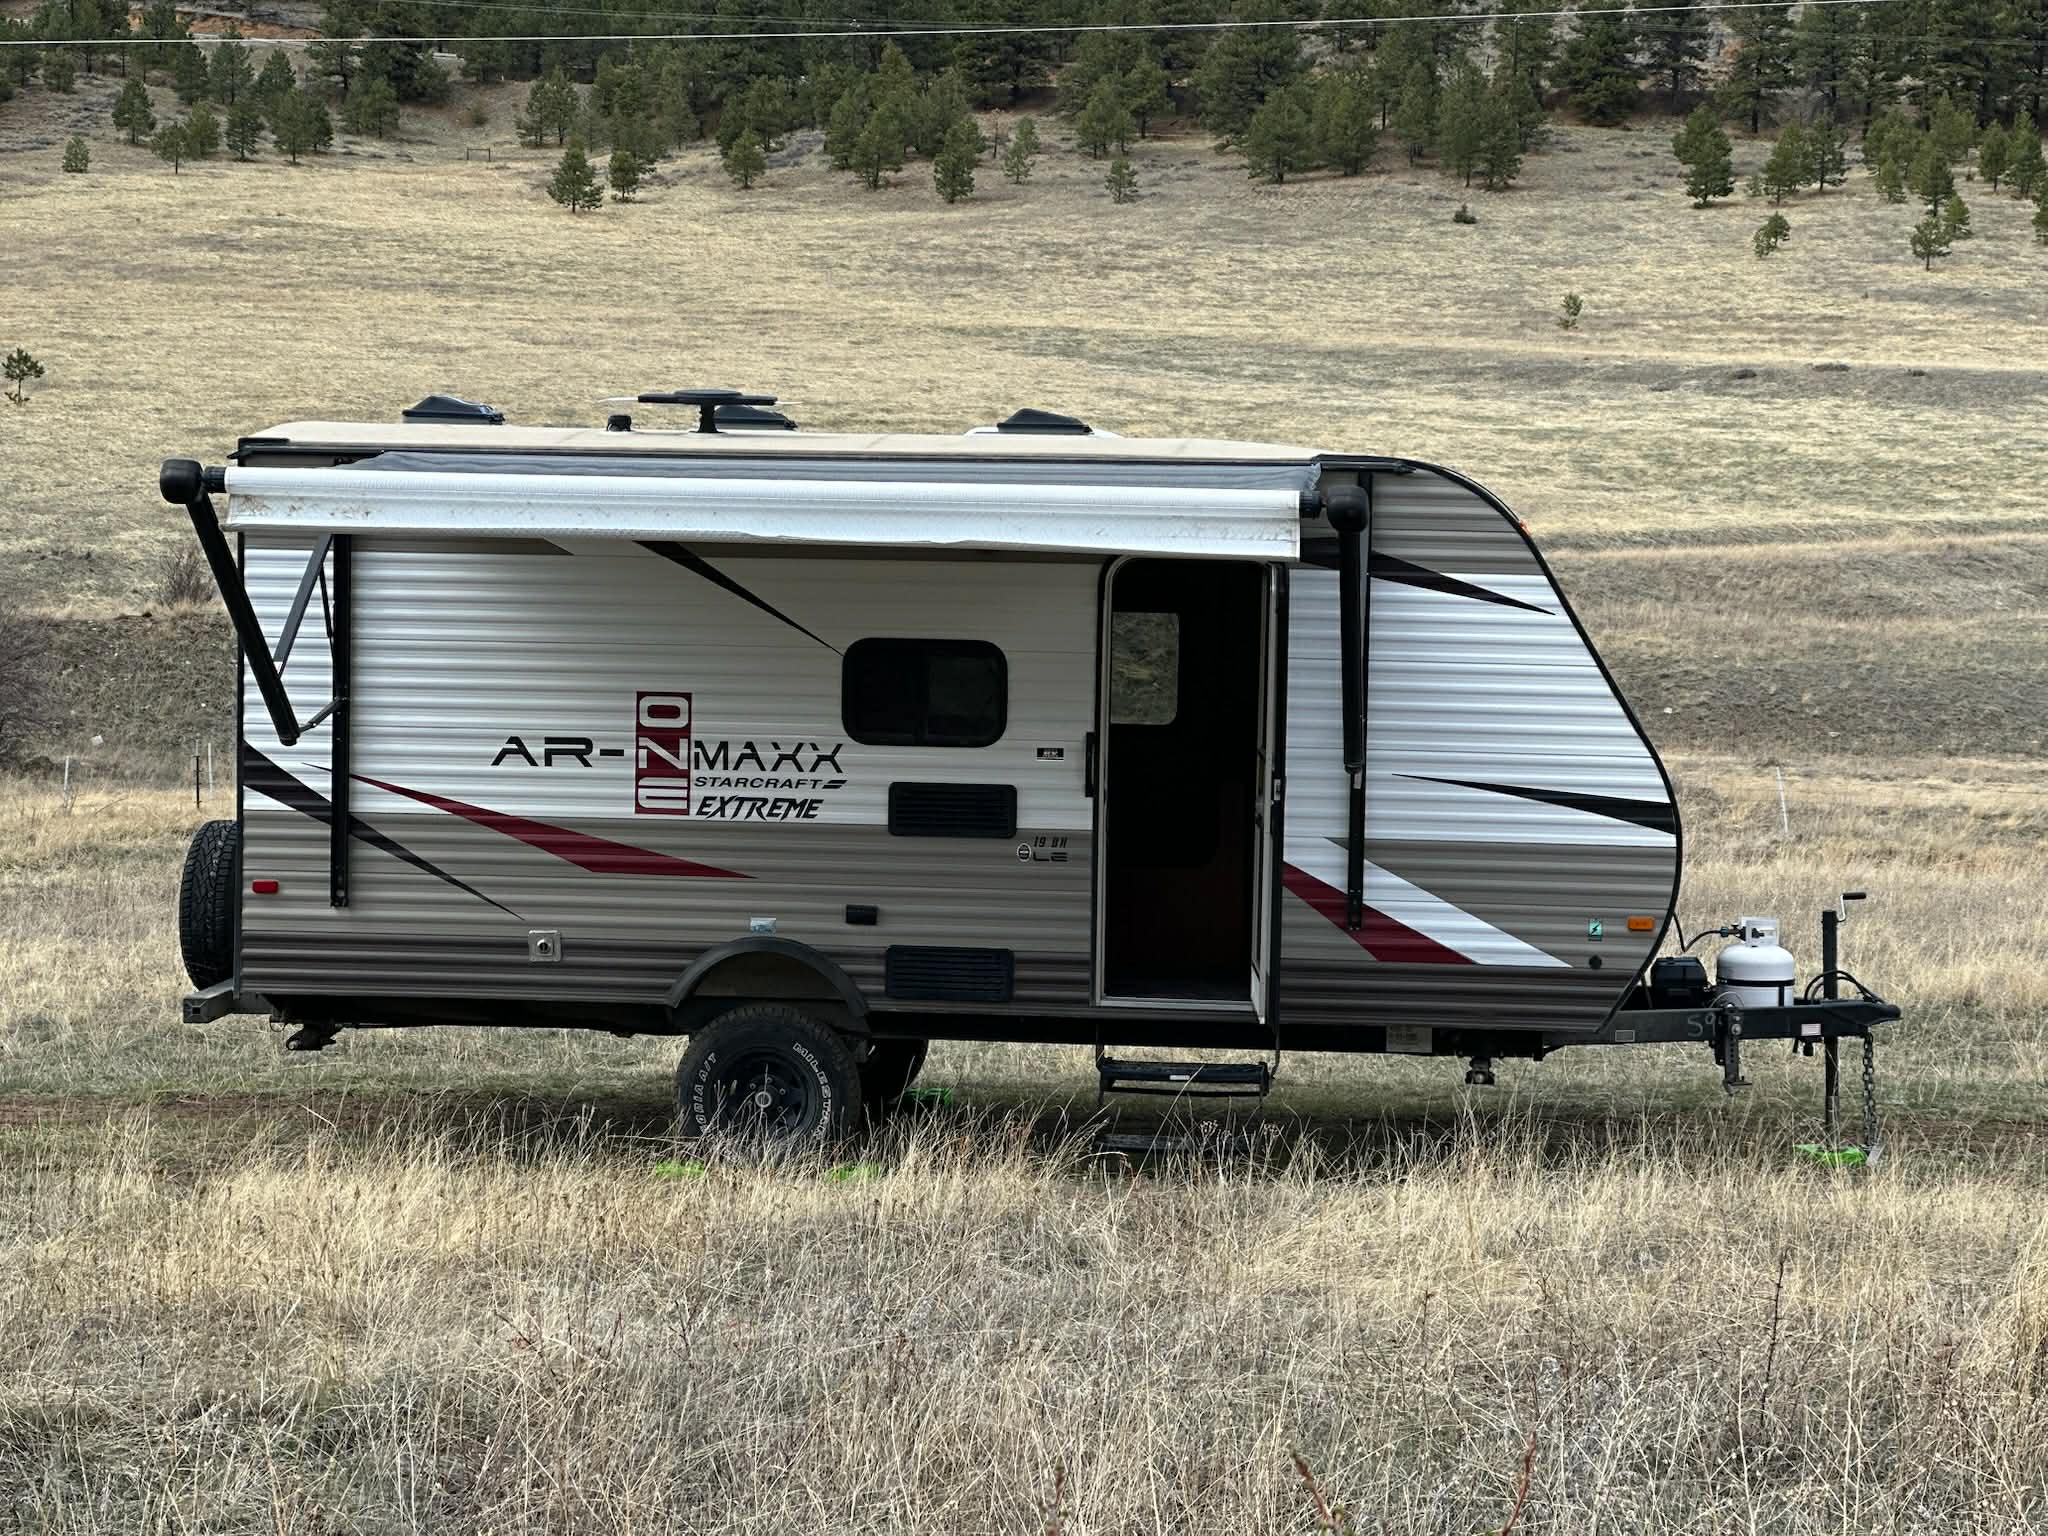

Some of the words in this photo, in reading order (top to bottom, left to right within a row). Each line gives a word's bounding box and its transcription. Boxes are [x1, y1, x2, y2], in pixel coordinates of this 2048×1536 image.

[694, 740, 844, 774] MAXX
[694, 776, 823, 790] STARCRAFT
[695, 795, 825, 823] EXTREME
